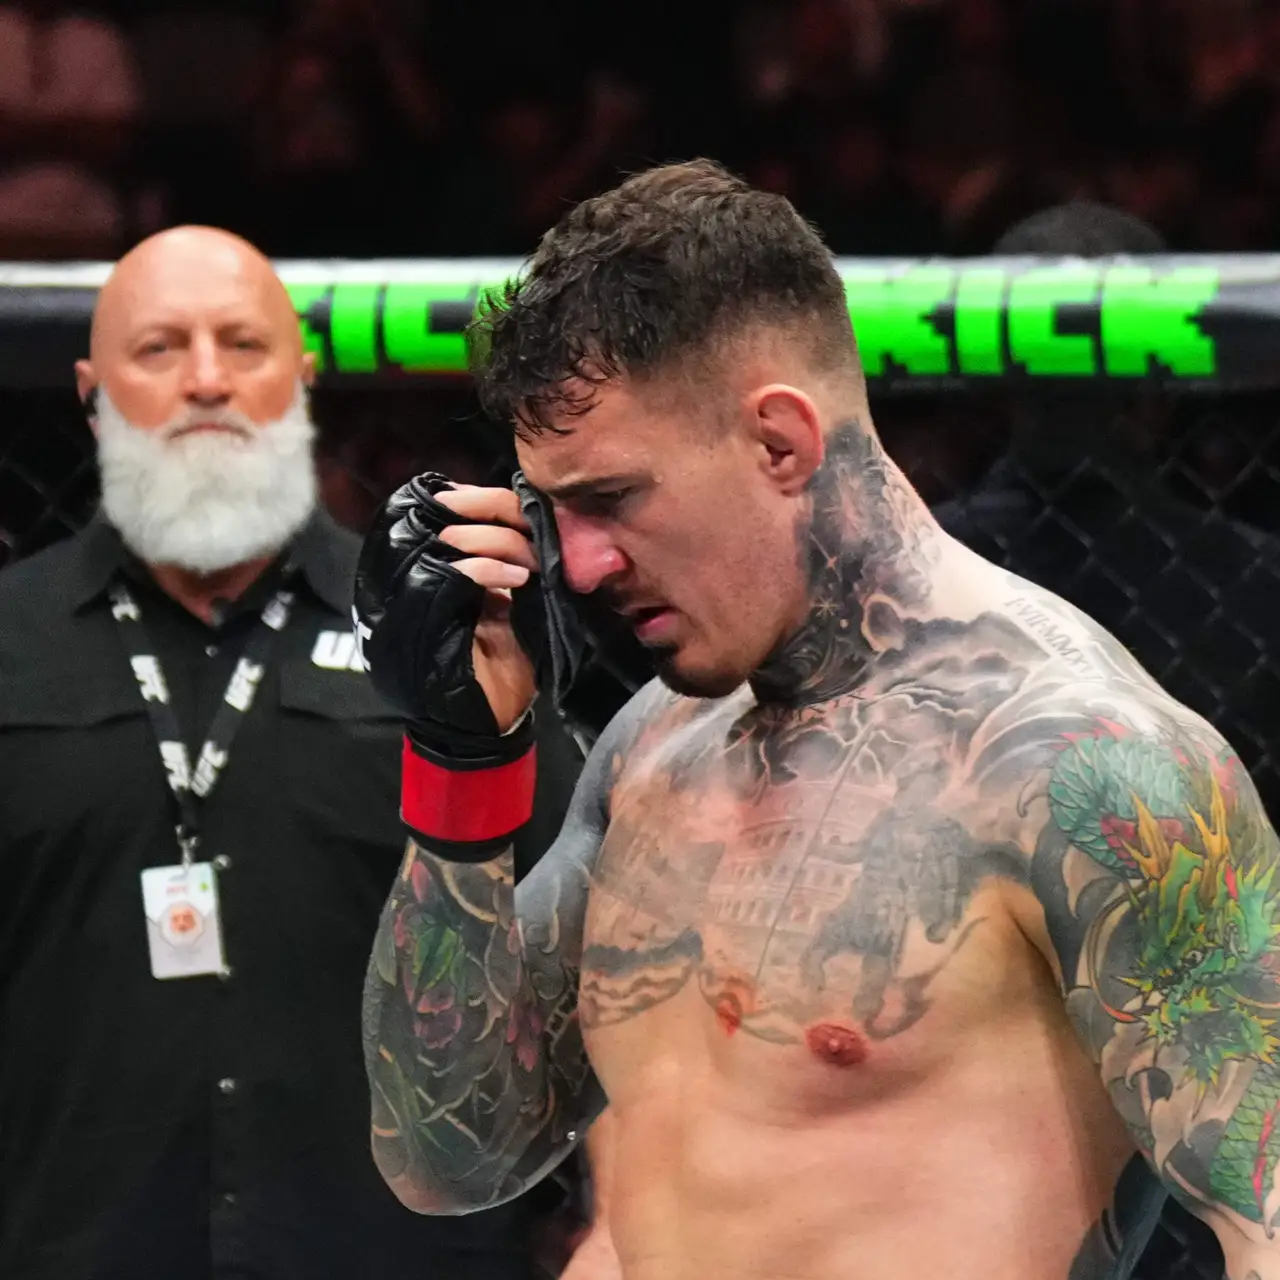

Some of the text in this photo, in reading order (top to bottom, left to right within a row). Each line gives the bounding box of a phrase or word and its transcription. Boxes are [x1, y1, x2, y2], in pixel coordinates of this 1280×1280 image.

[285, 278, 508, 373] IC
[843, 265, 1219, 376] KICK
[224, 657, 264, 712] UFC
[190, 739, 229, 798] UFC
